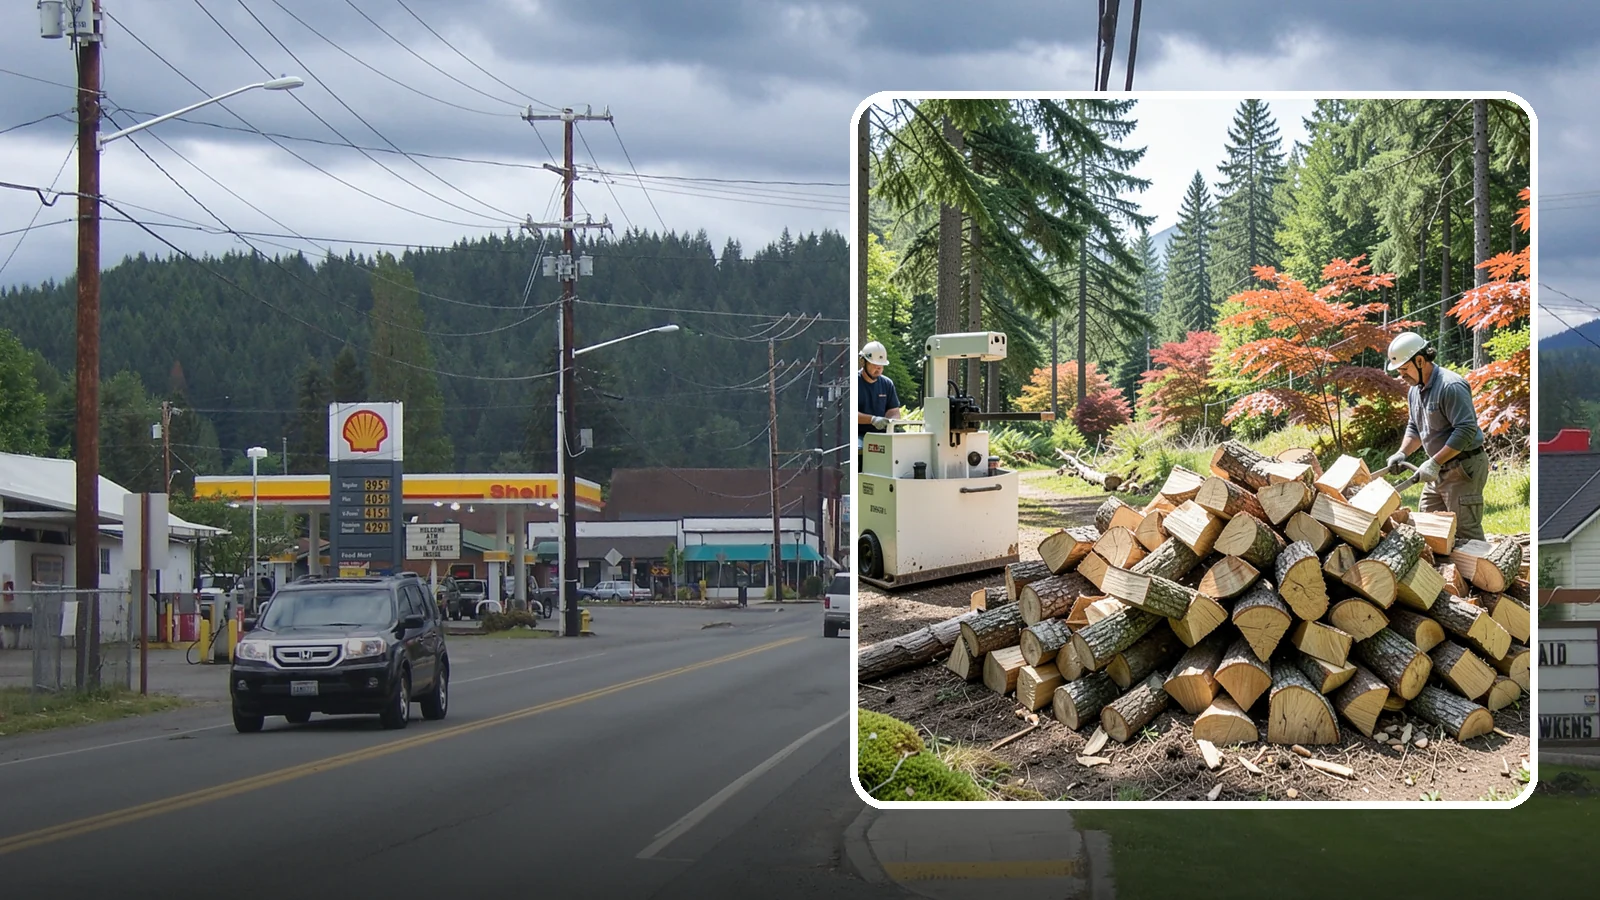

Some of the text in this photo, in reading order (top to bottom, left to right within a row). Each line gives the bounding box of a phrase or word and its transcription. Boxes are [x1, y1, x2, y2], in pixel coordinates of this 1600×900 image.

[490, 484, 547, 499] Shell
[365, 494, 383, 504] 405
[365, 508, 383, 518] 415
[365, 522, 383, 532] 429
